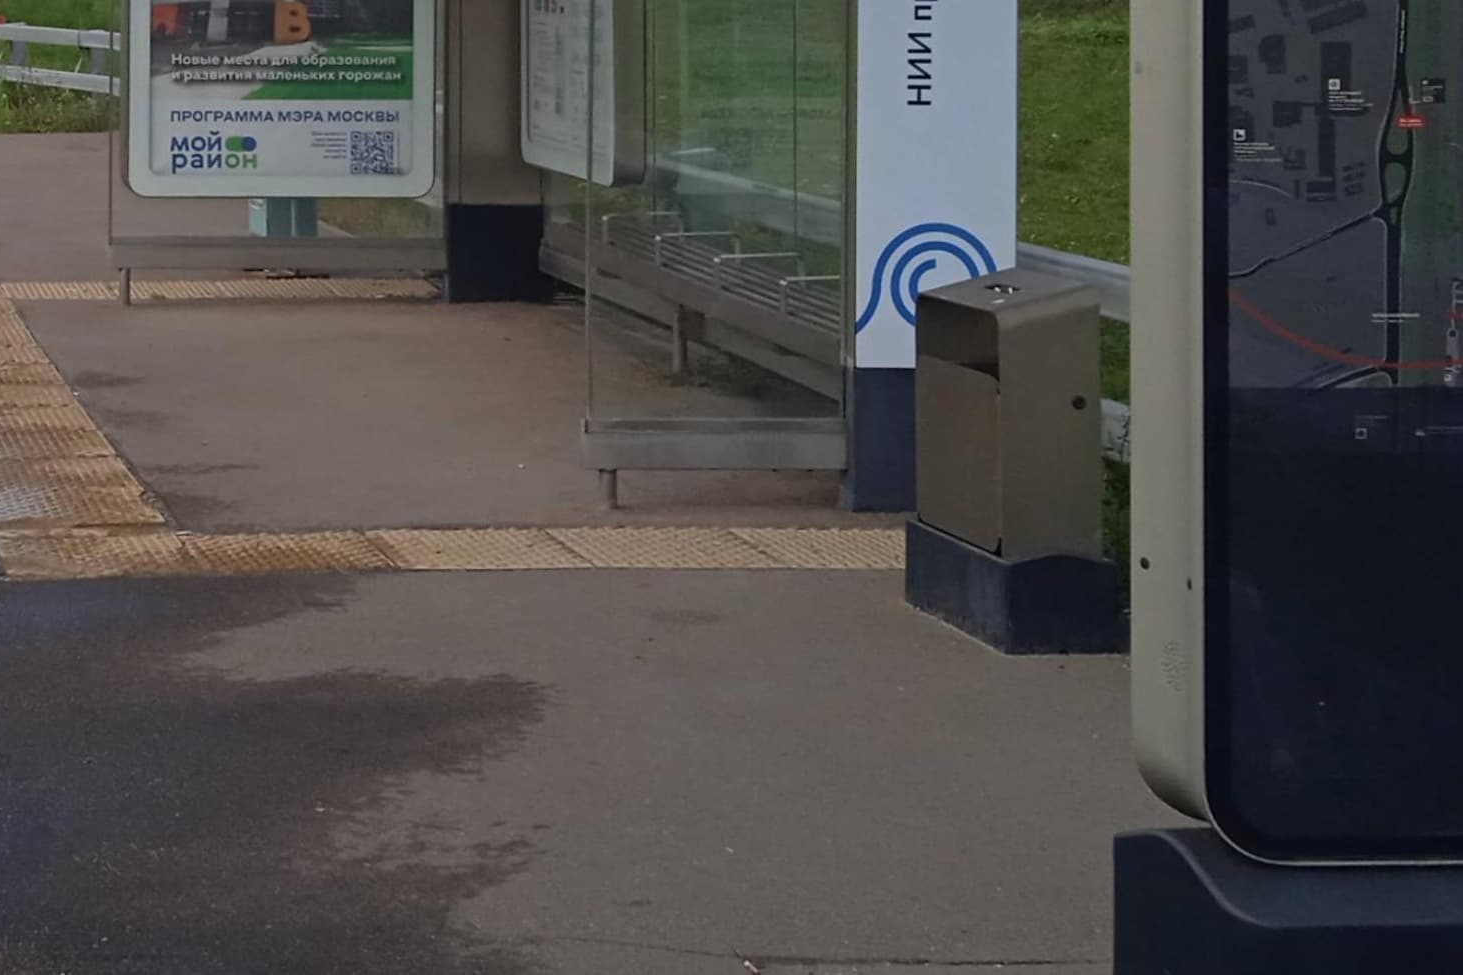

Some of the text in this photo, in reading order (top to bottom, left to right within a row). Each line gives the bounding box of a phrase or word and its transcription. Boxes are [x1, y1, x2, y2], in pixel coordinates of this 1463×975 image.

[171, 53, 396, 67] Новые места для образования
[906, 32, 932, 106] НИИ
[171, 70, 402, 83] и развития маленьких горожан
[170, 110, 400, 123] ПРОГРАММА МЭРА МОСКВЫ
